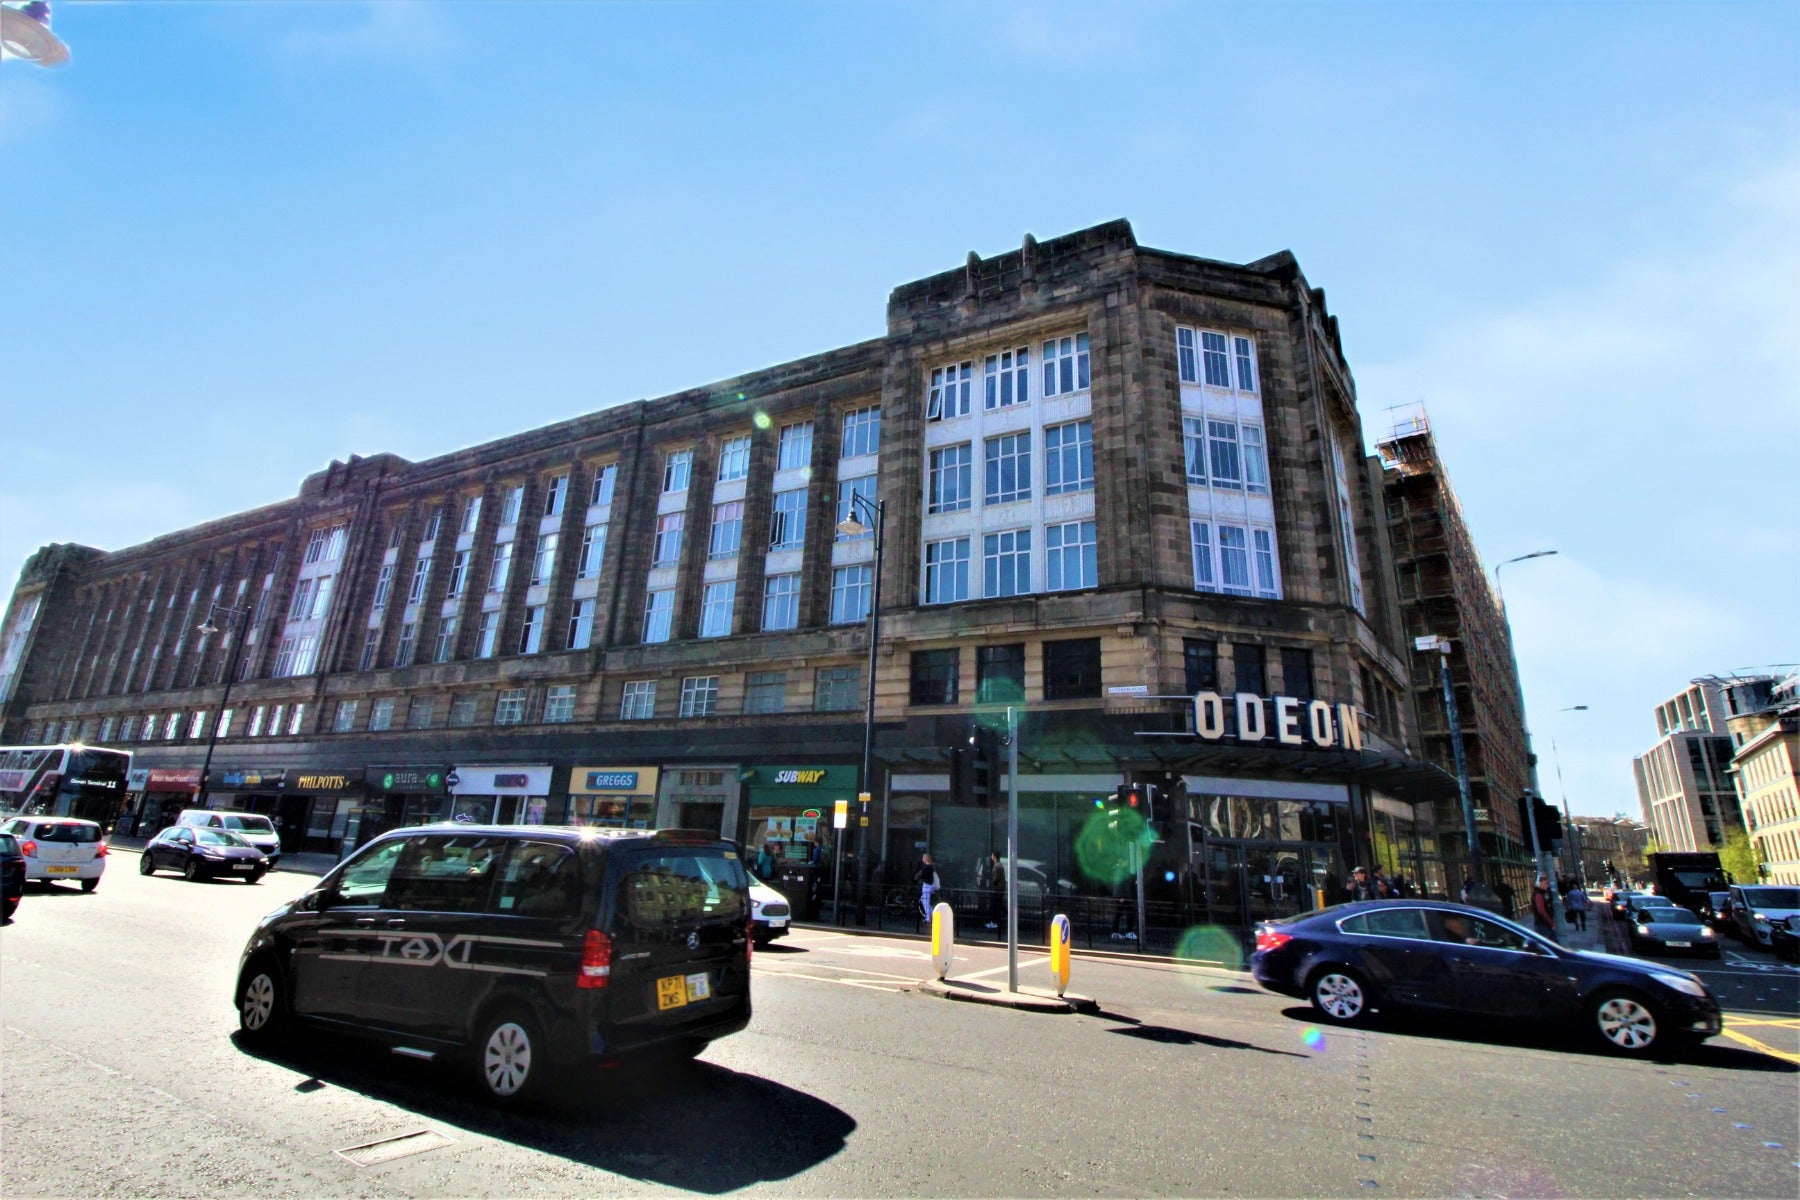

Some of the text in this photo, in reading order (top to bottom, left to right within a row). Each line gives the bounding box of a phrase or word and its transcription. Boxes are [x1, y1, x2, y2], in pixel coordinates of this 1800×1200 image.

[1193, 691, 1362, 751] ODEON
[297, 775, 345, 789] PHILPOTTS
[394, 772, 418, 784] aura
[595, 774, 633, 786] GREGGS
[774, 770, 821, 784] SUBWAY
[107, 781, 117, 789] 11
[377, 933, 472, 969] TAXI
